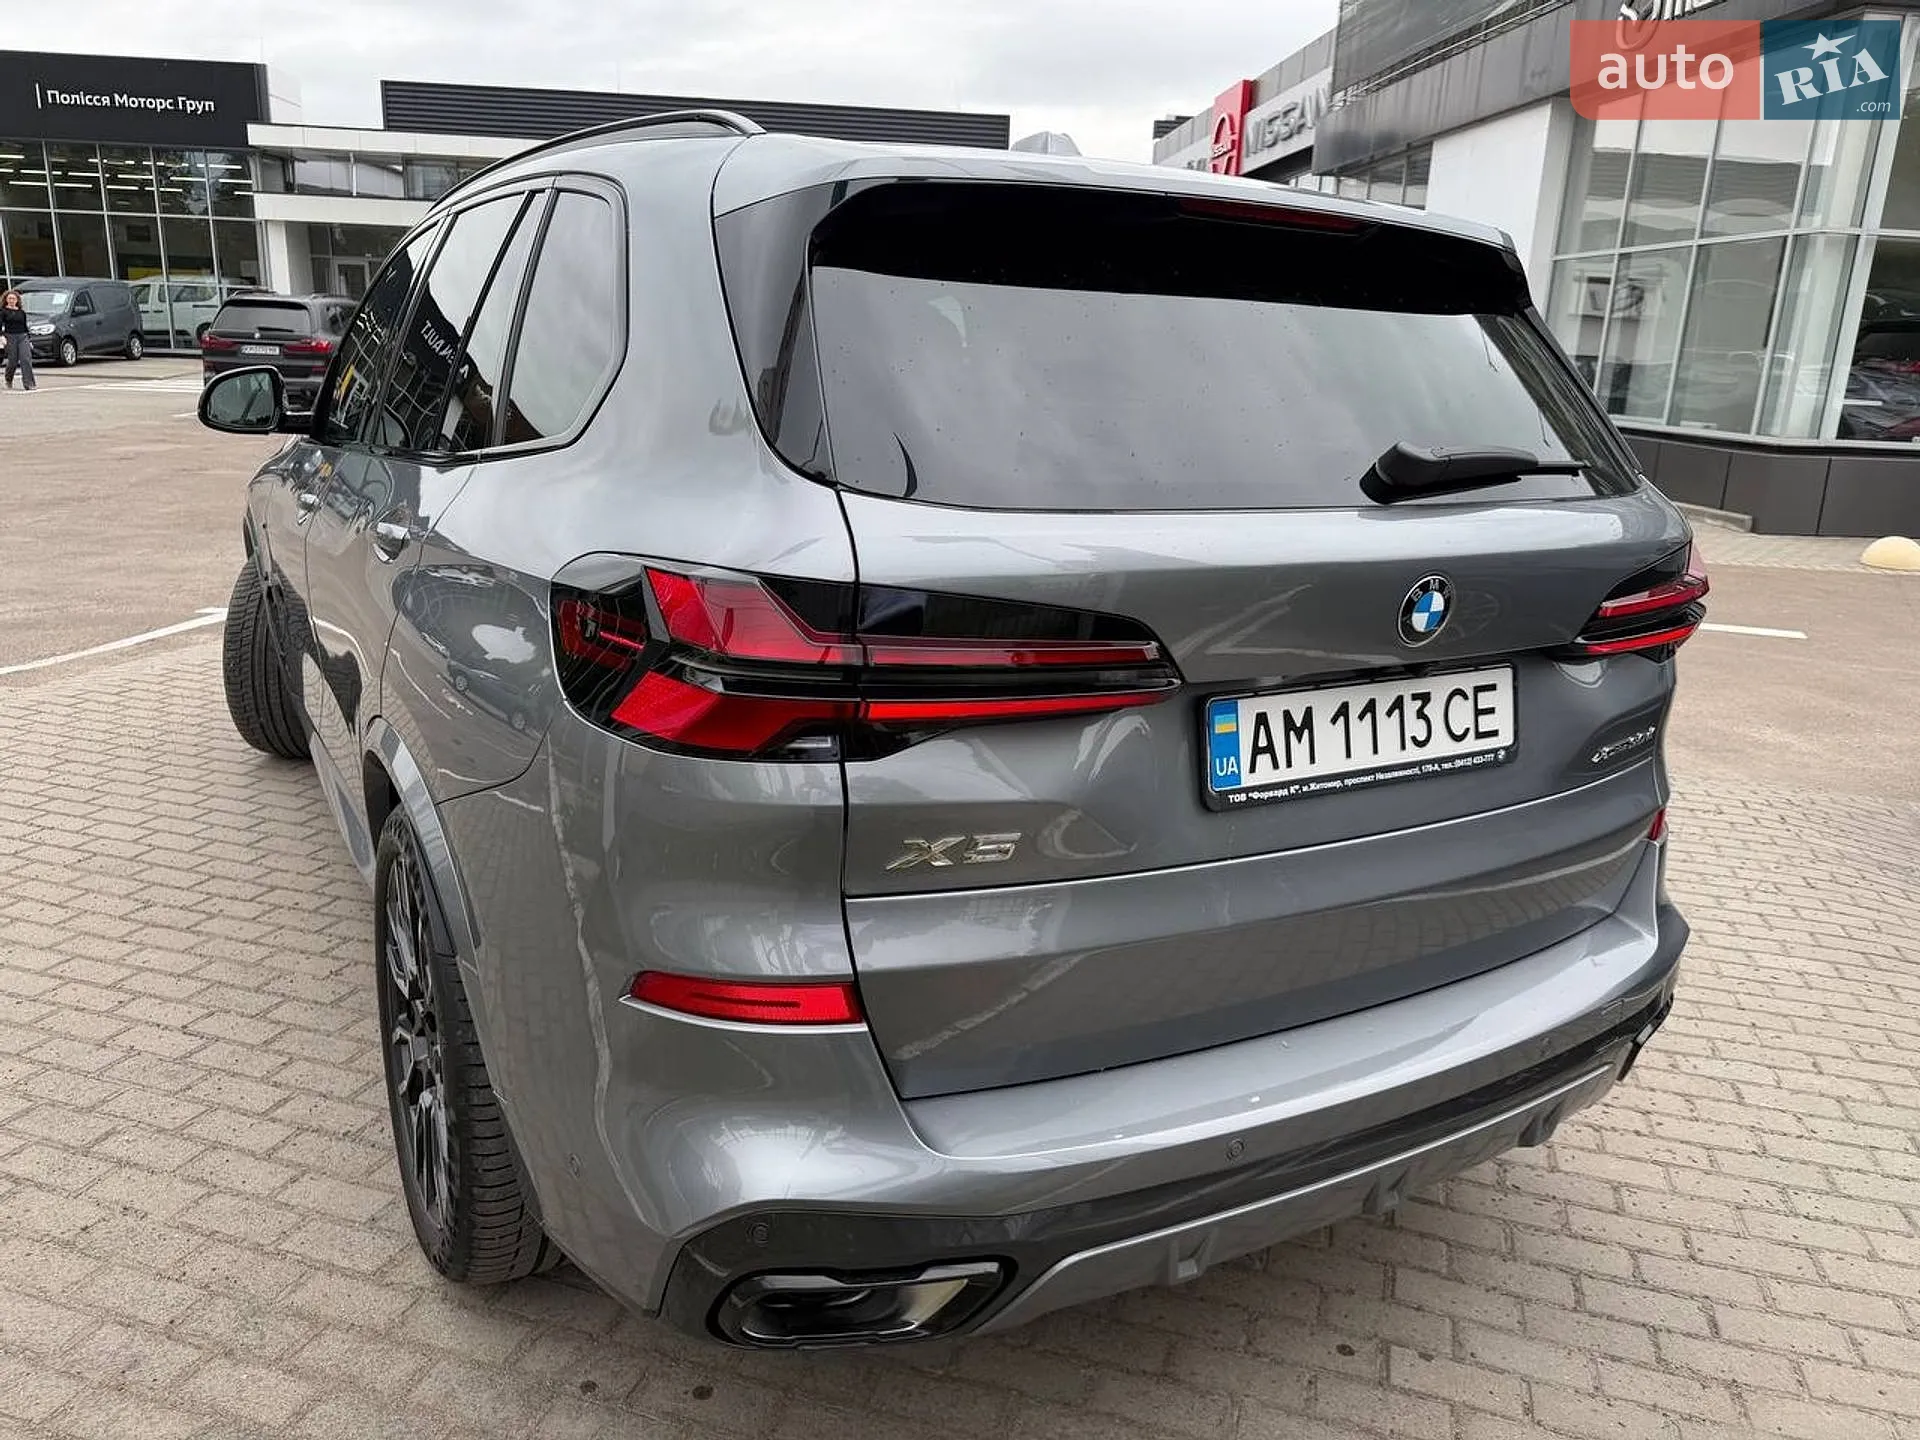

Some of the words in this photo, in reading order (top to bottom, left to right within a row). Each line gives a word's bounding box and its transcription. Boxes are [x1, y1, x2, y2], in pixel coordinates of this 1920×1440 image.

[46, 89, 111, 107] Полісся
[113, 92, 174, 112] Моторс
[177, 95, 215, 115] Груп
[1248, 705, 1316, 774] AM
[1330, 691, 1432, 759] 1113
[1443, 683, 1500, 743] CE
[1215, 756, 1239, 777] UA
[885, 832, 1022, 870] X5
